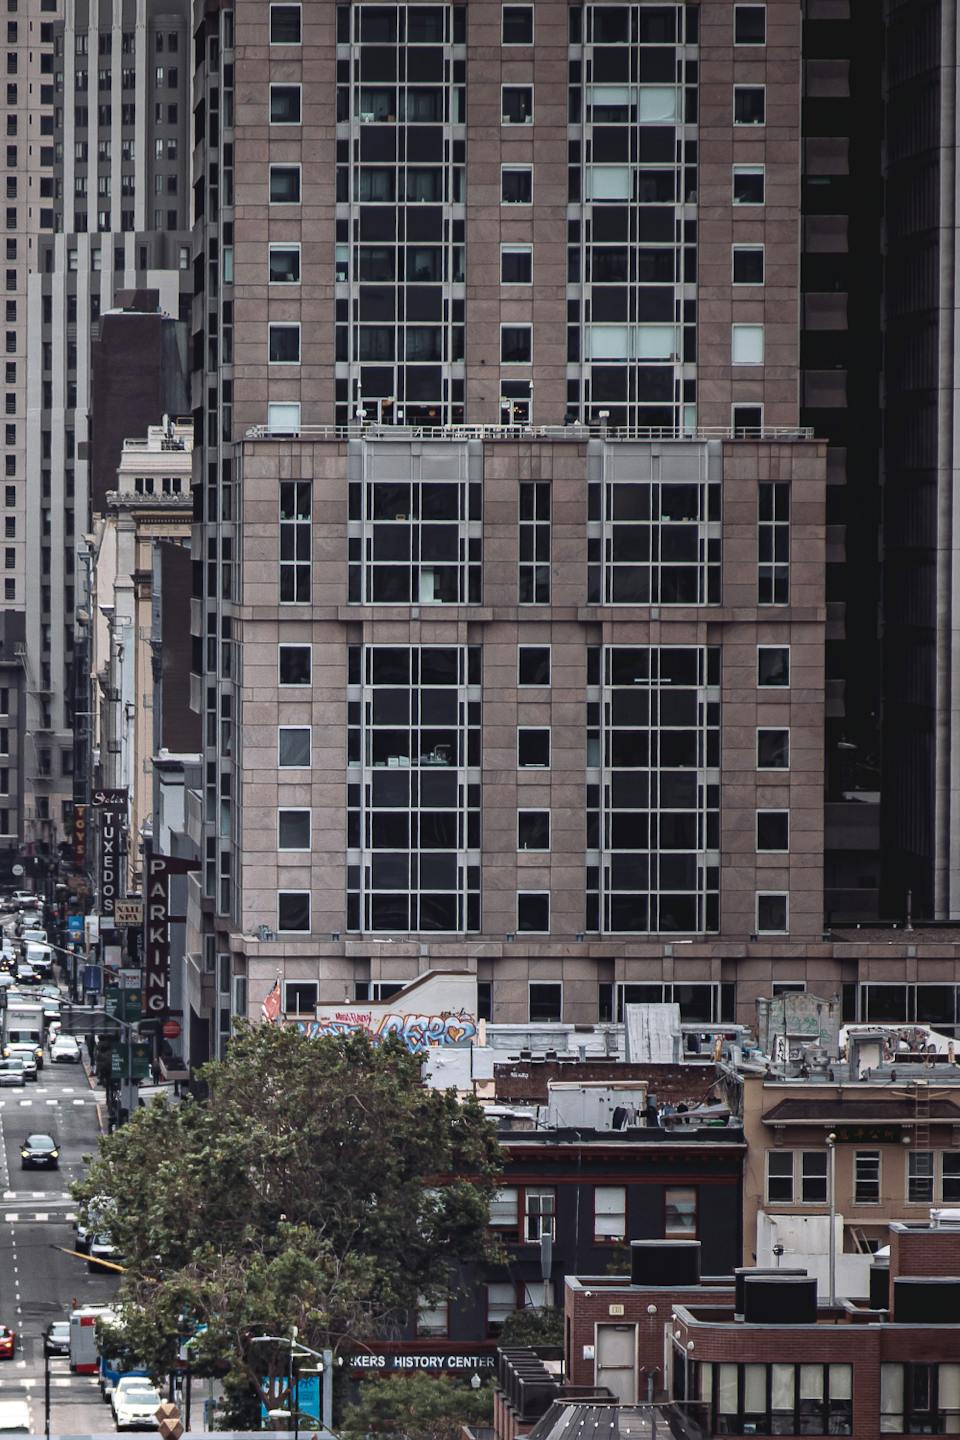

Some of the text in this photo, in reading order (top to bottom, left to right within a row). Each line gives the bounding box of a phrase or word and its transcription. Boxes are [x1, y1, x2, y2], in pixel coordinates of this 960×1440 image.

[76, 807, 85, 854] TOYS
[103, 812, 115, 911] TUXEDOS
[116, 905, 140, 913] NAIL
[148, 860, 167, 1010] PARKING
[394, 1356, 444, 1368] HISTORY
[448, 1357, 495, 1368] CENTER
